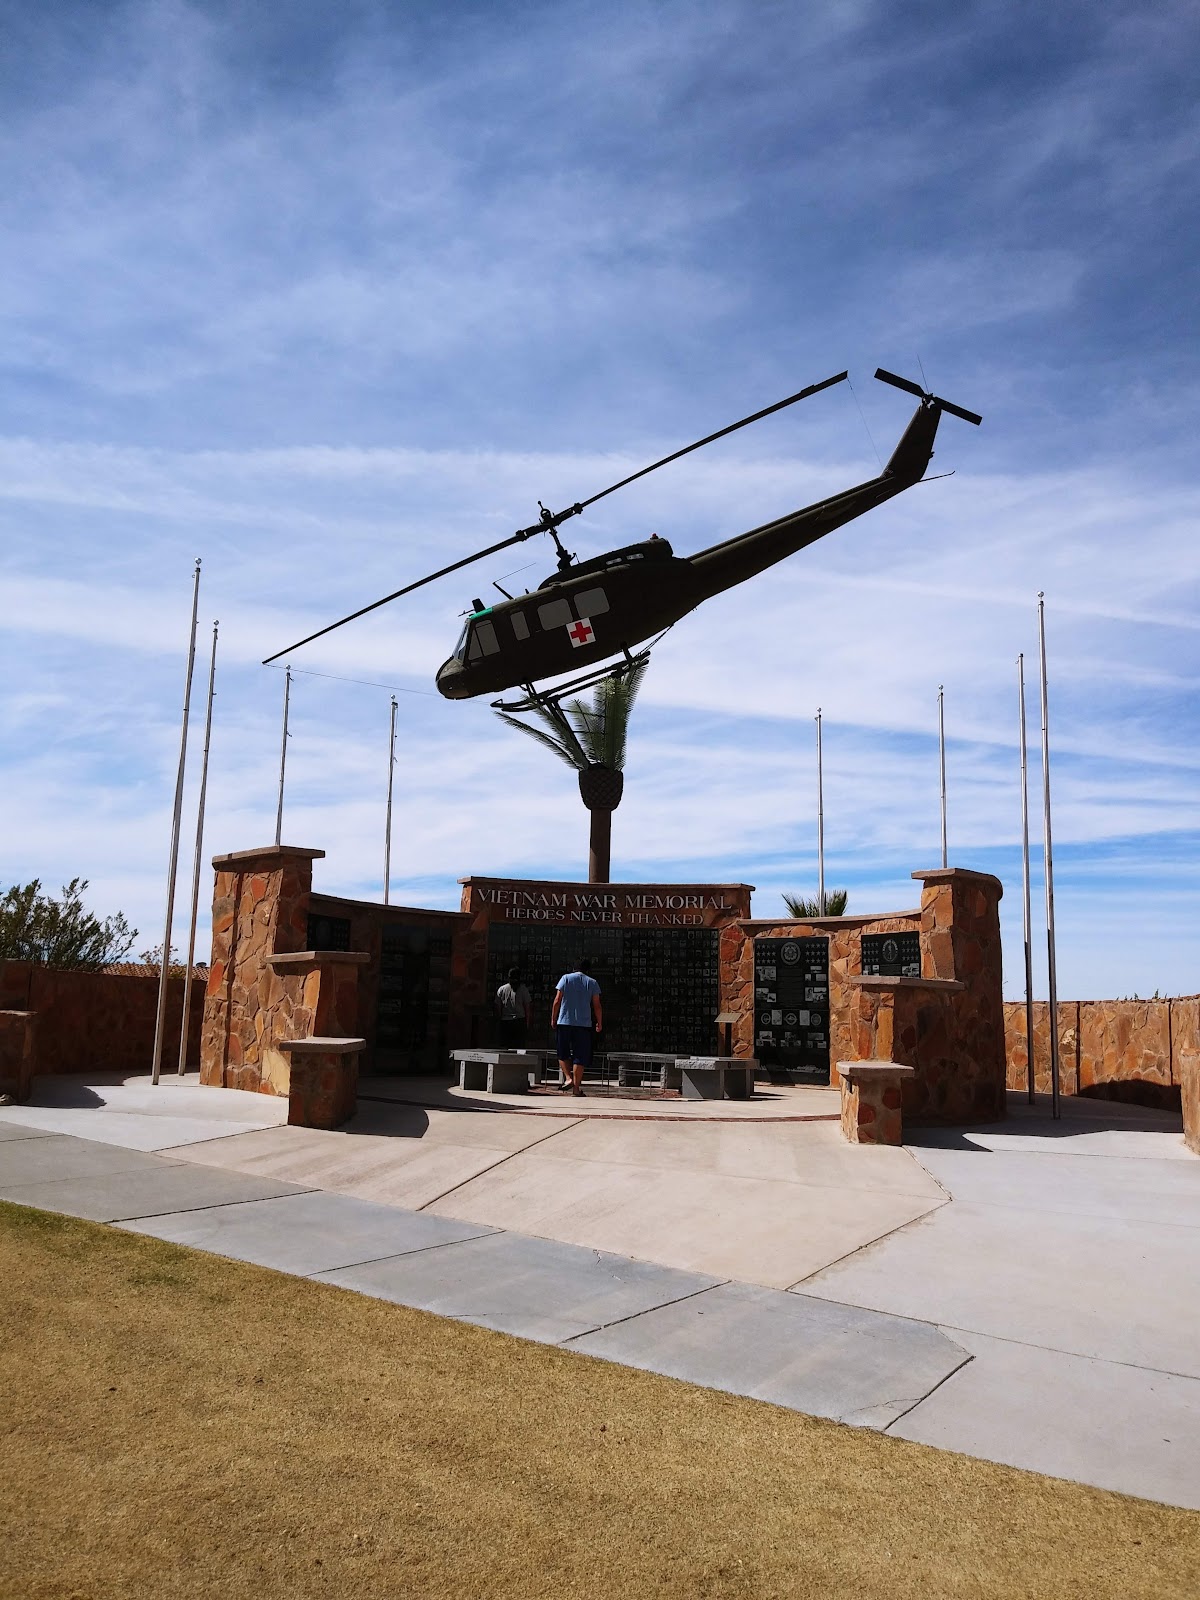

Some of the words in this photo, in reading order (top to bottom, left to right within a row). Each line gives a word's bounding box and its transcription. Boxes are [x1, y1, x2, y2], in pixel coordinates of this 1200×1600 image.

[477, 888, 567, 907] VIETNAM
[574, 895, 616, 908] WAR
[625, 895, 732, 910] MEMORIAL
[505, 907, 565, 921] HEROES
[570, 911, 622, 923] NEVER
[628, 912, 704, 925] THANKED
